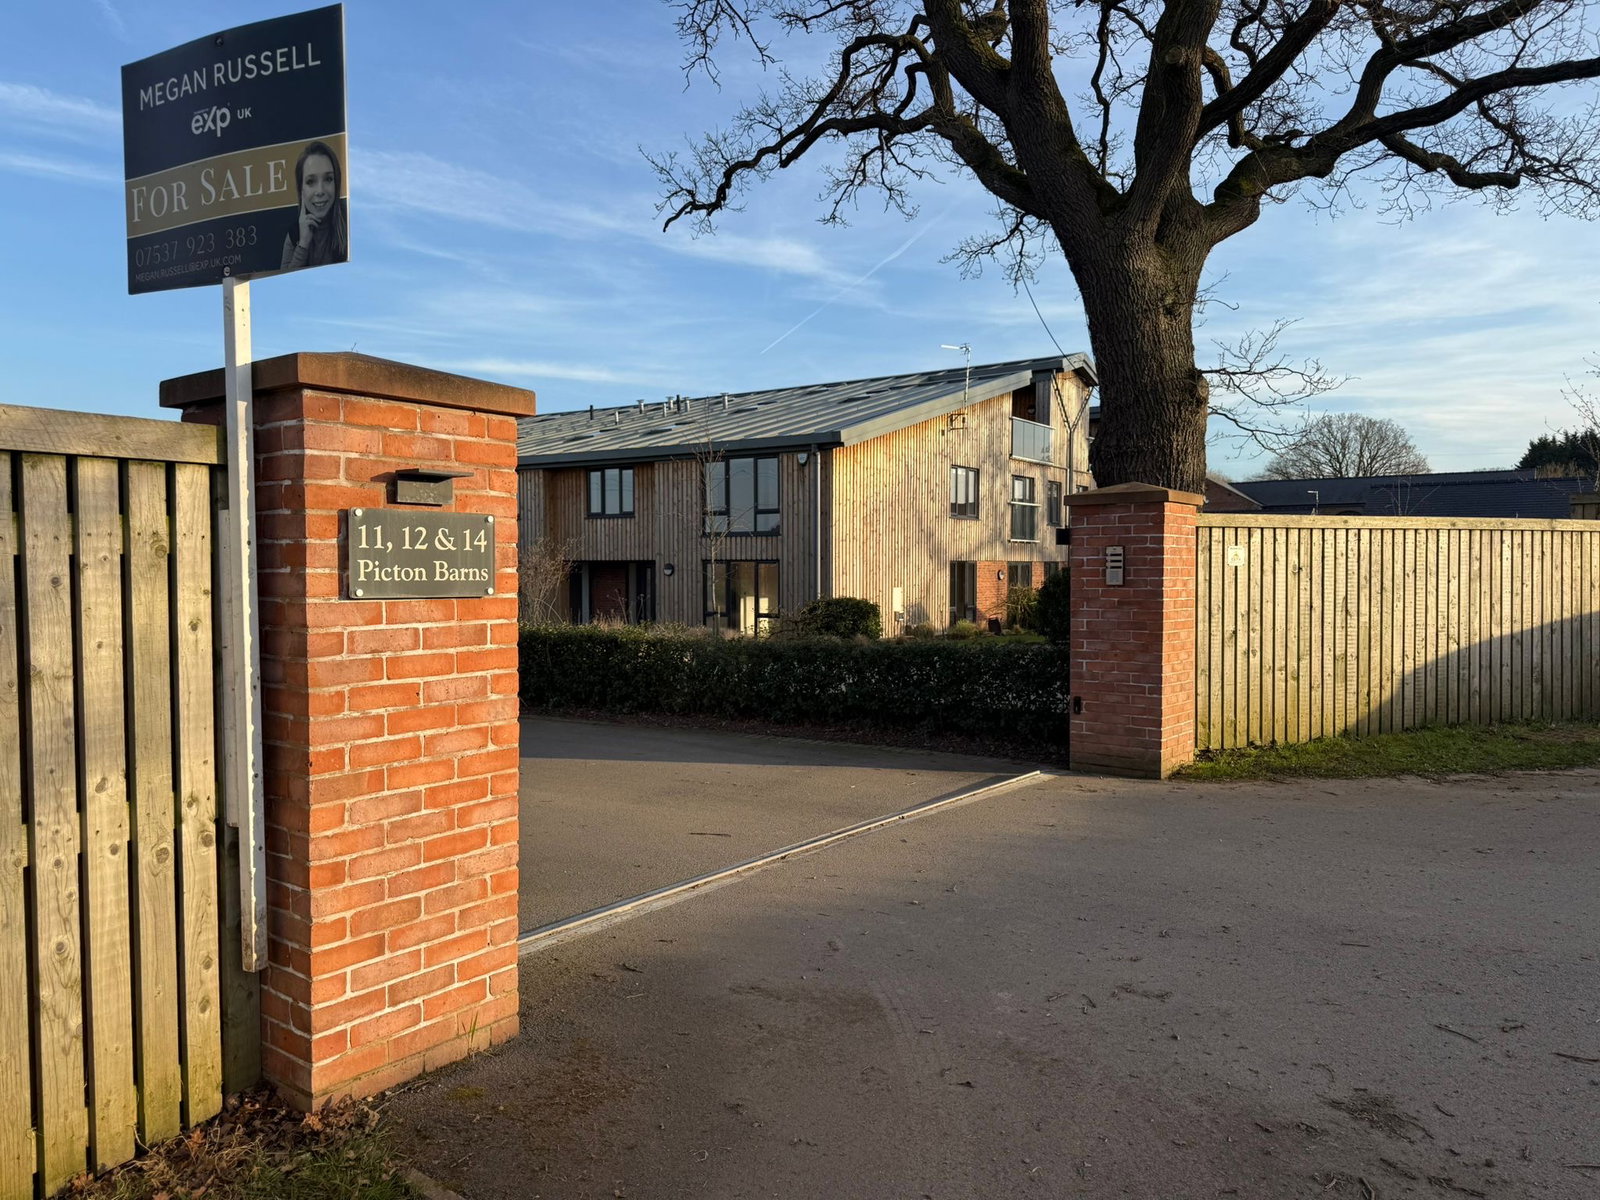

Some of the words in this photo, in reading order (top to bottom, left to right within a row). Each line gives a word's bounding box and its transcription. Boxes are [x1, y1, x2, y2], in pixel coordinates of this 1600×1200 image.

[139, 68, 207, 111] MEGAN
[214, 43, 321, 87] RUSSELL
[191, 105, 231, 137] exp
[237, 107, 252, 120] UK
[131, 181, 189, 223] FOR
[200, 160, 288, 206] SALE
[135, 241, 179, 268] 07537
[186, 233, 215, 256] 923
[225, 226, 257, 250] 383
[358, 524, 393, 553] 11,
[402, 526, 429, 550] 12
[434, 527, 457, 551] &
[463, 528, 488, 553] 14
[357, 559, 428, 582] Picton
[433, 560, 489, 582] Barns
